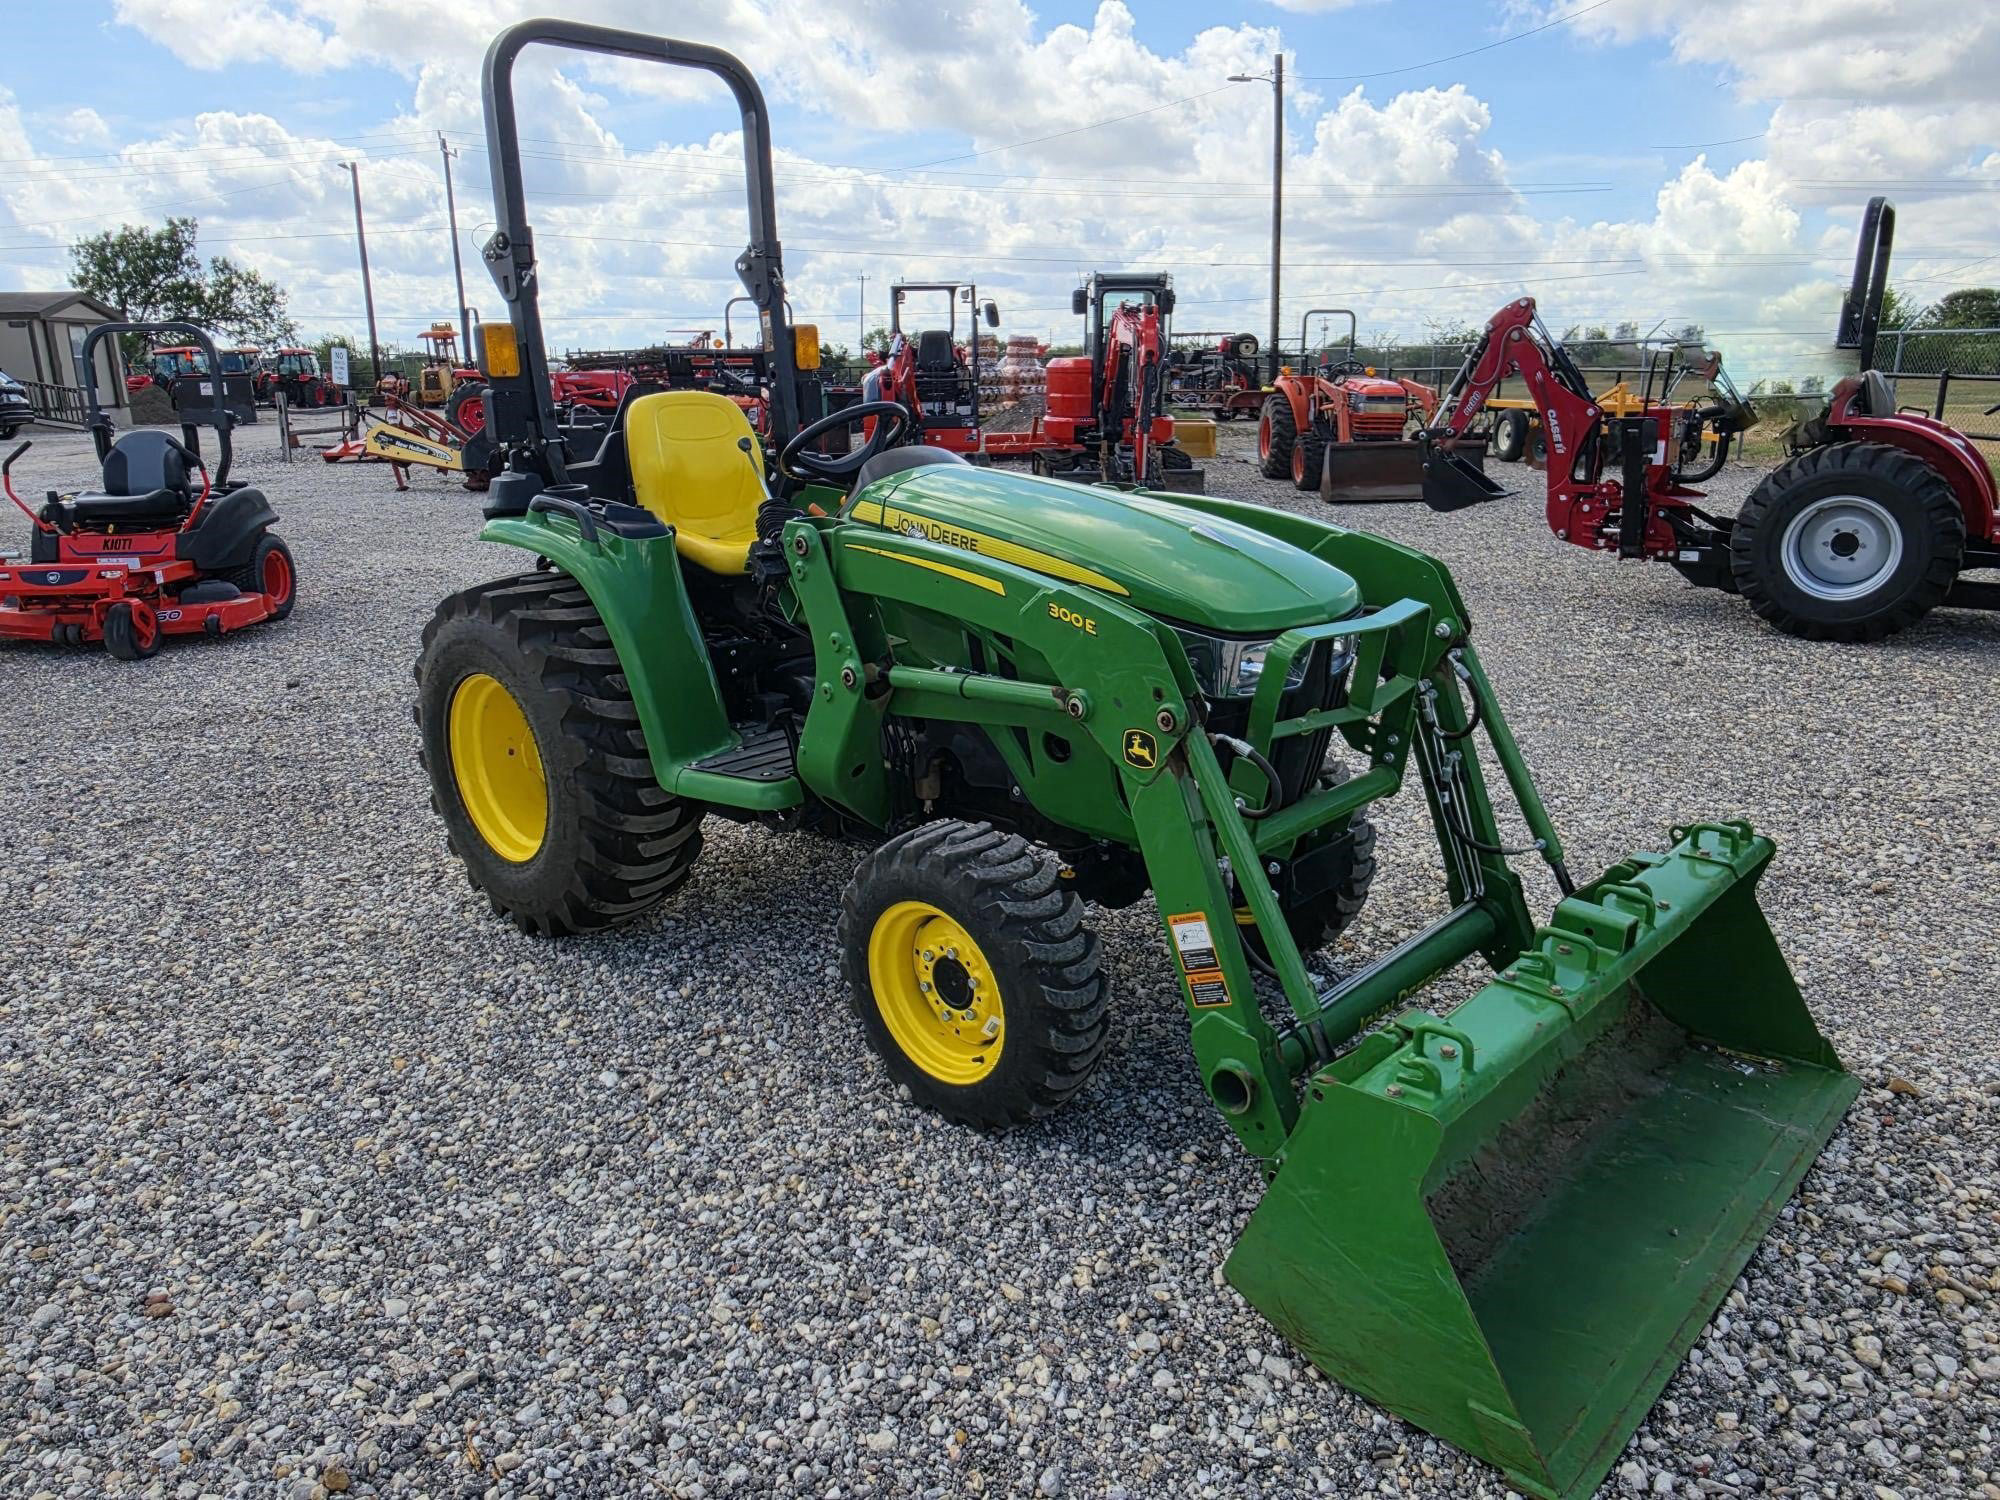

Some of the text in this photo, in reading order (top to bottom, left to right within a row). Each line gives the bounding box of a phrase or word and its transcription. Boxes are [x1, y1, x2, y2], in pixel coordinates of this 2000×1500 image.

[335, 351, 344, 360] NO
[1547, 409, 1562, 442] CASE
[102, 538, 133, 551] KIOTI
[931, 523, 978, 552] DEERE
